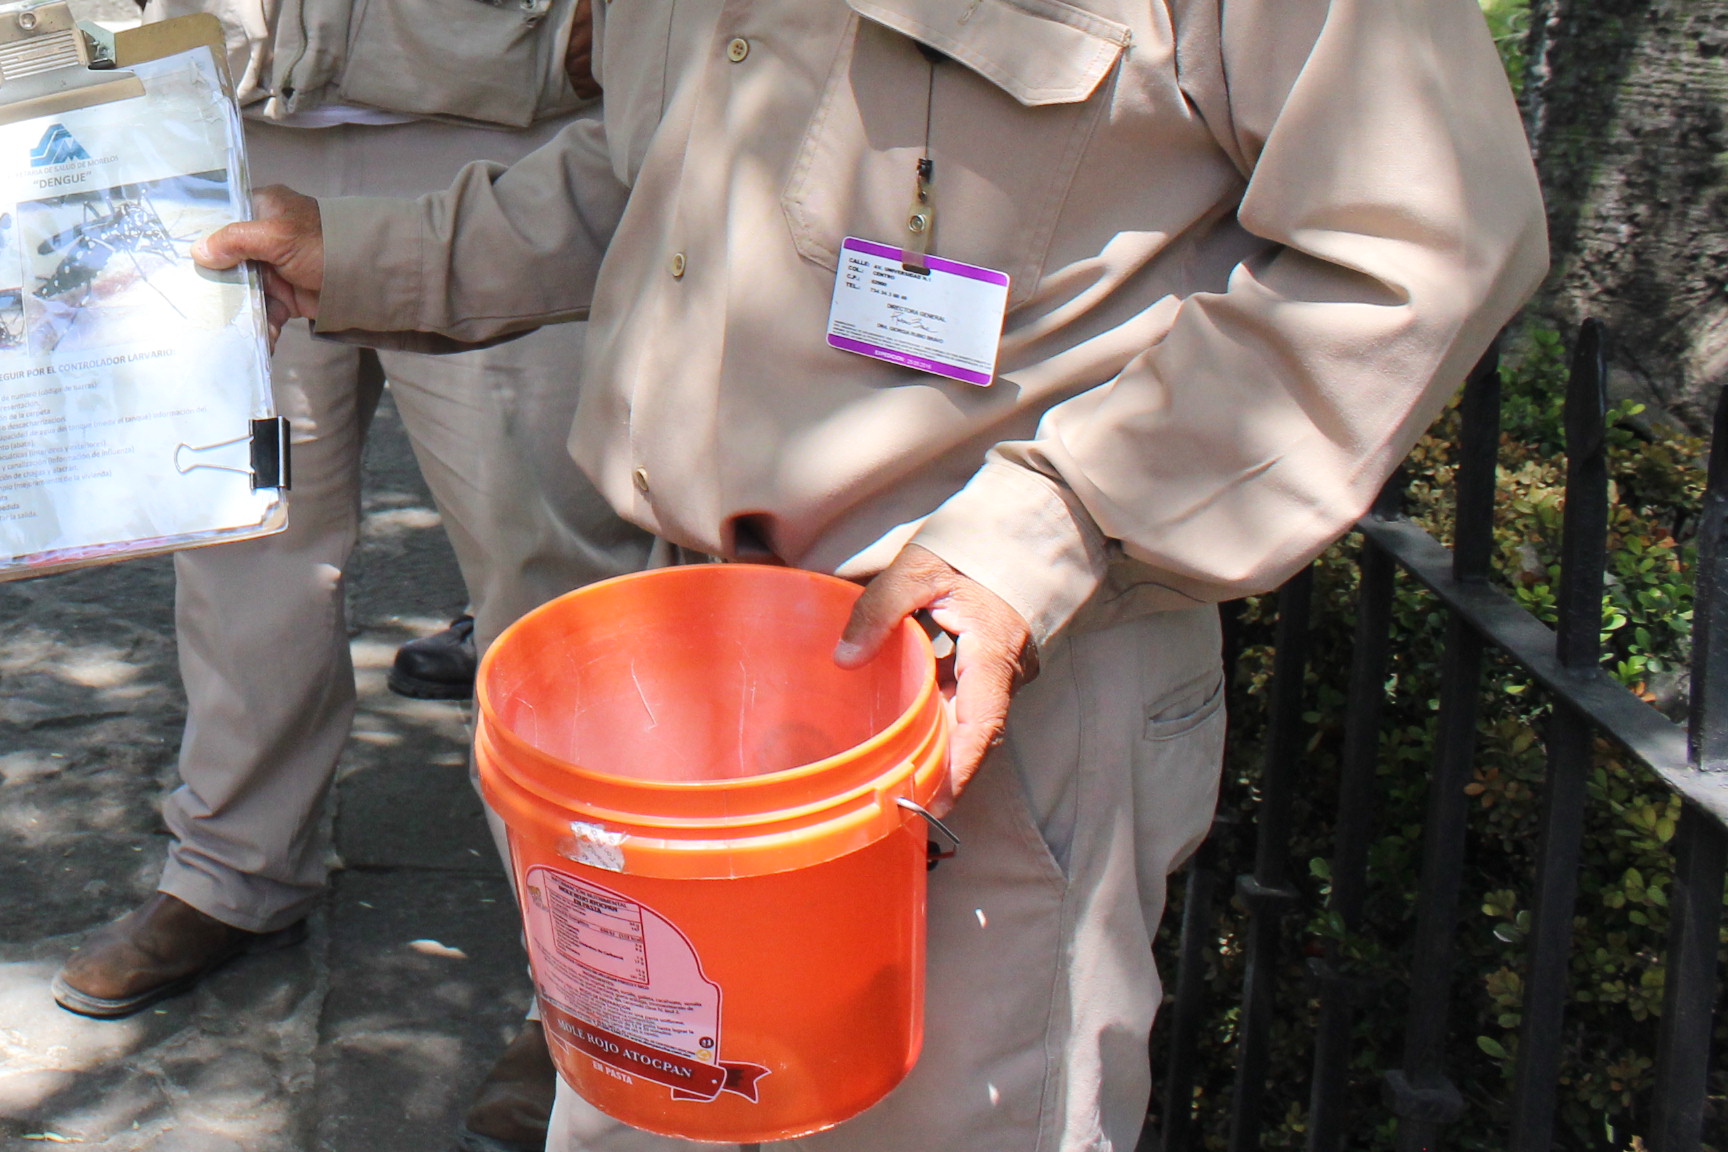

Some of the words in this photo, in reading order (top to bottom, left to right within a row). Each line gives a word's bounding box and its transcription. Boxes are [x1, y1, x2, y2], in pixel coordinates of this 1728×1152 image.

[54, 164, 76, 172] SALUD
[88, 155, 119, 166] MORELOS
[886, 303, 919, 315] DIRECTORA
[919, 311, 948, 322] GENERAL
[27, 368, 46, 378] POR
[47, 366, 57, 375] EL
[58, 356, 126, 373] CONTROLADOR
[13, 472, 22, 480] de
[557, 1018, 585, 1040] MOLE
[587, 1033, 619, 1055] ROJO
[622, 1048, 693, 1079] ATOCPAN
[592, 1060, 604, 1072] EN
[605, 1066, 633, 1085] PASTA
